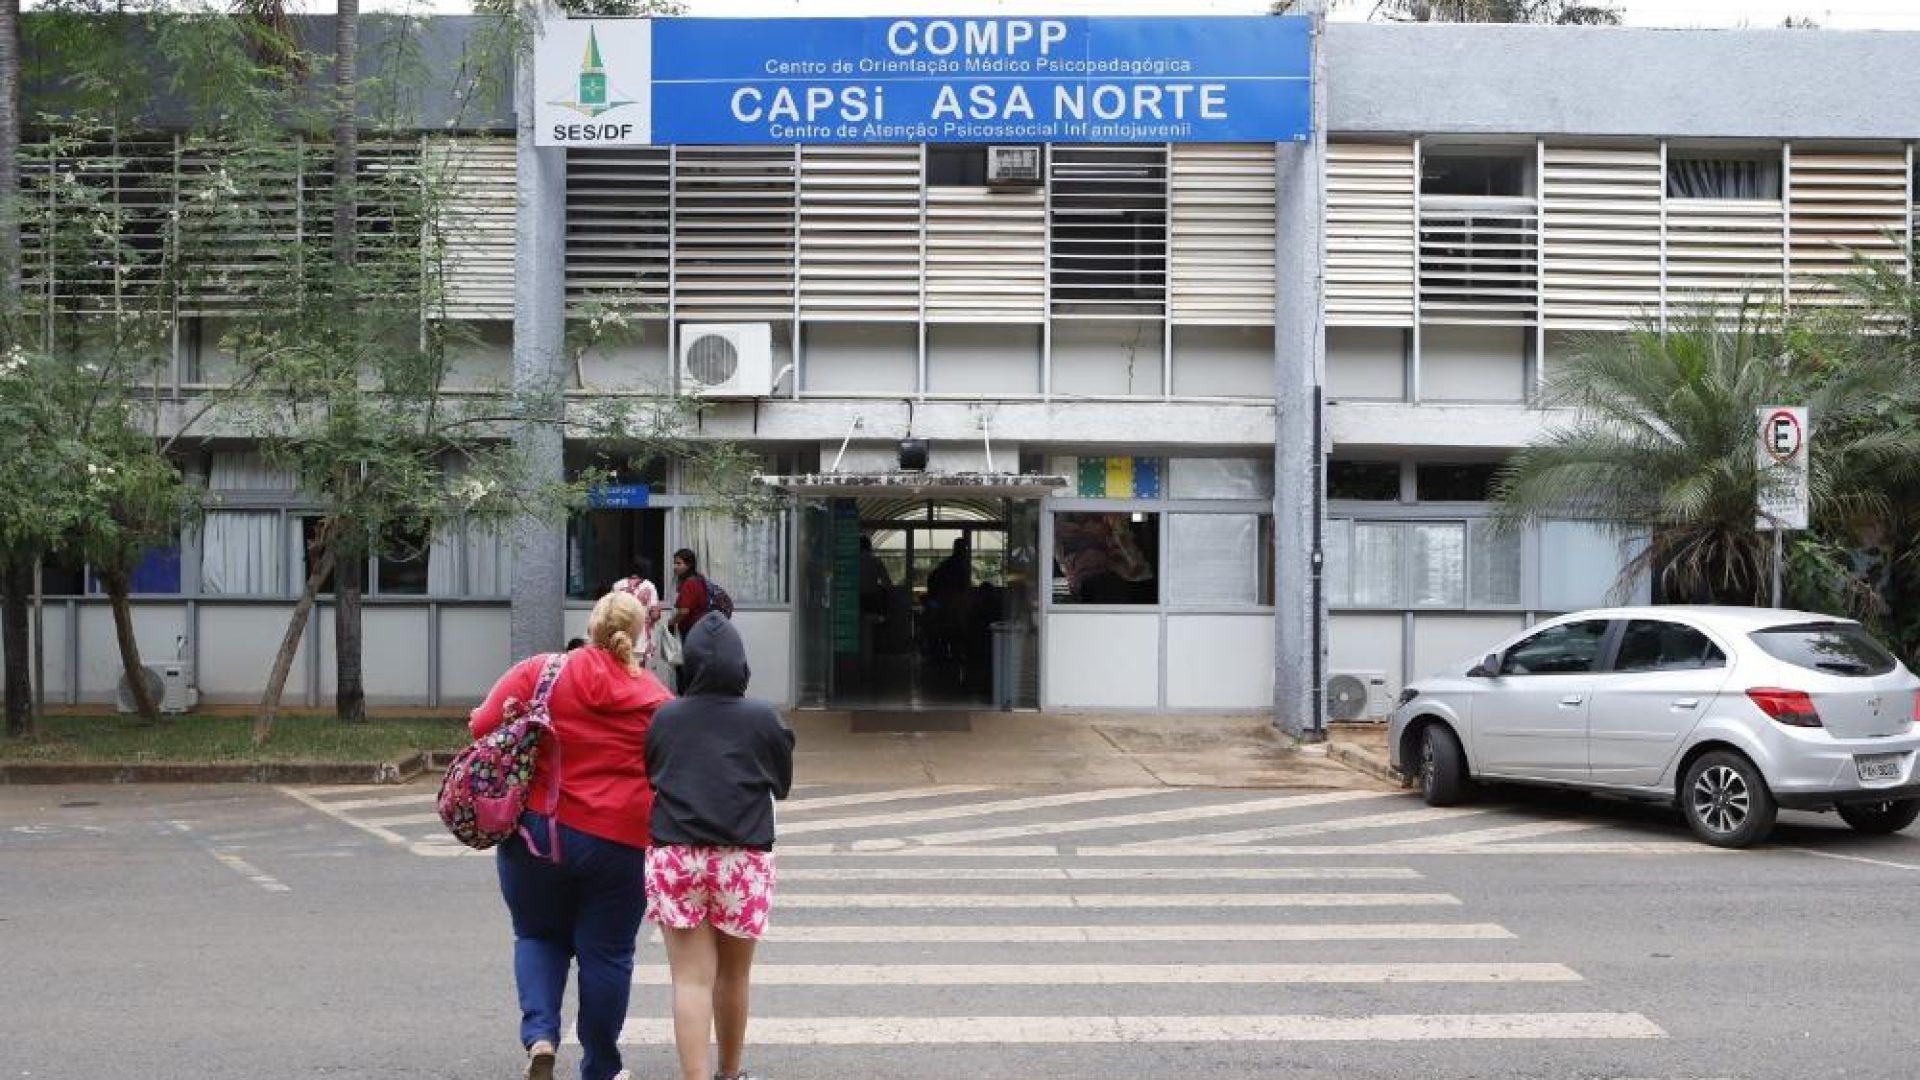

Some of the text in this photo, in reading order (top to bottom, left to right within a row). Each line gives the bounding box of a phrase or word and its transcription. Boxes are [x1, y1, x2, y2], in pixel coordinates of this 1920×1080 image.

[888, 20, 1067, 55] COMPP
[765, 57, 1192, 76] Centro de Orientação Médico Psicopedagógica
[730, 84, 1228, 122] CAPSi ASA NORTE
[553, 123, 634, 141] SES/DF
[769, 121, 1192, 141] Centro de Atenção Psicossocial Infantojuvenil
[1774, 419, 1791, 454] E
